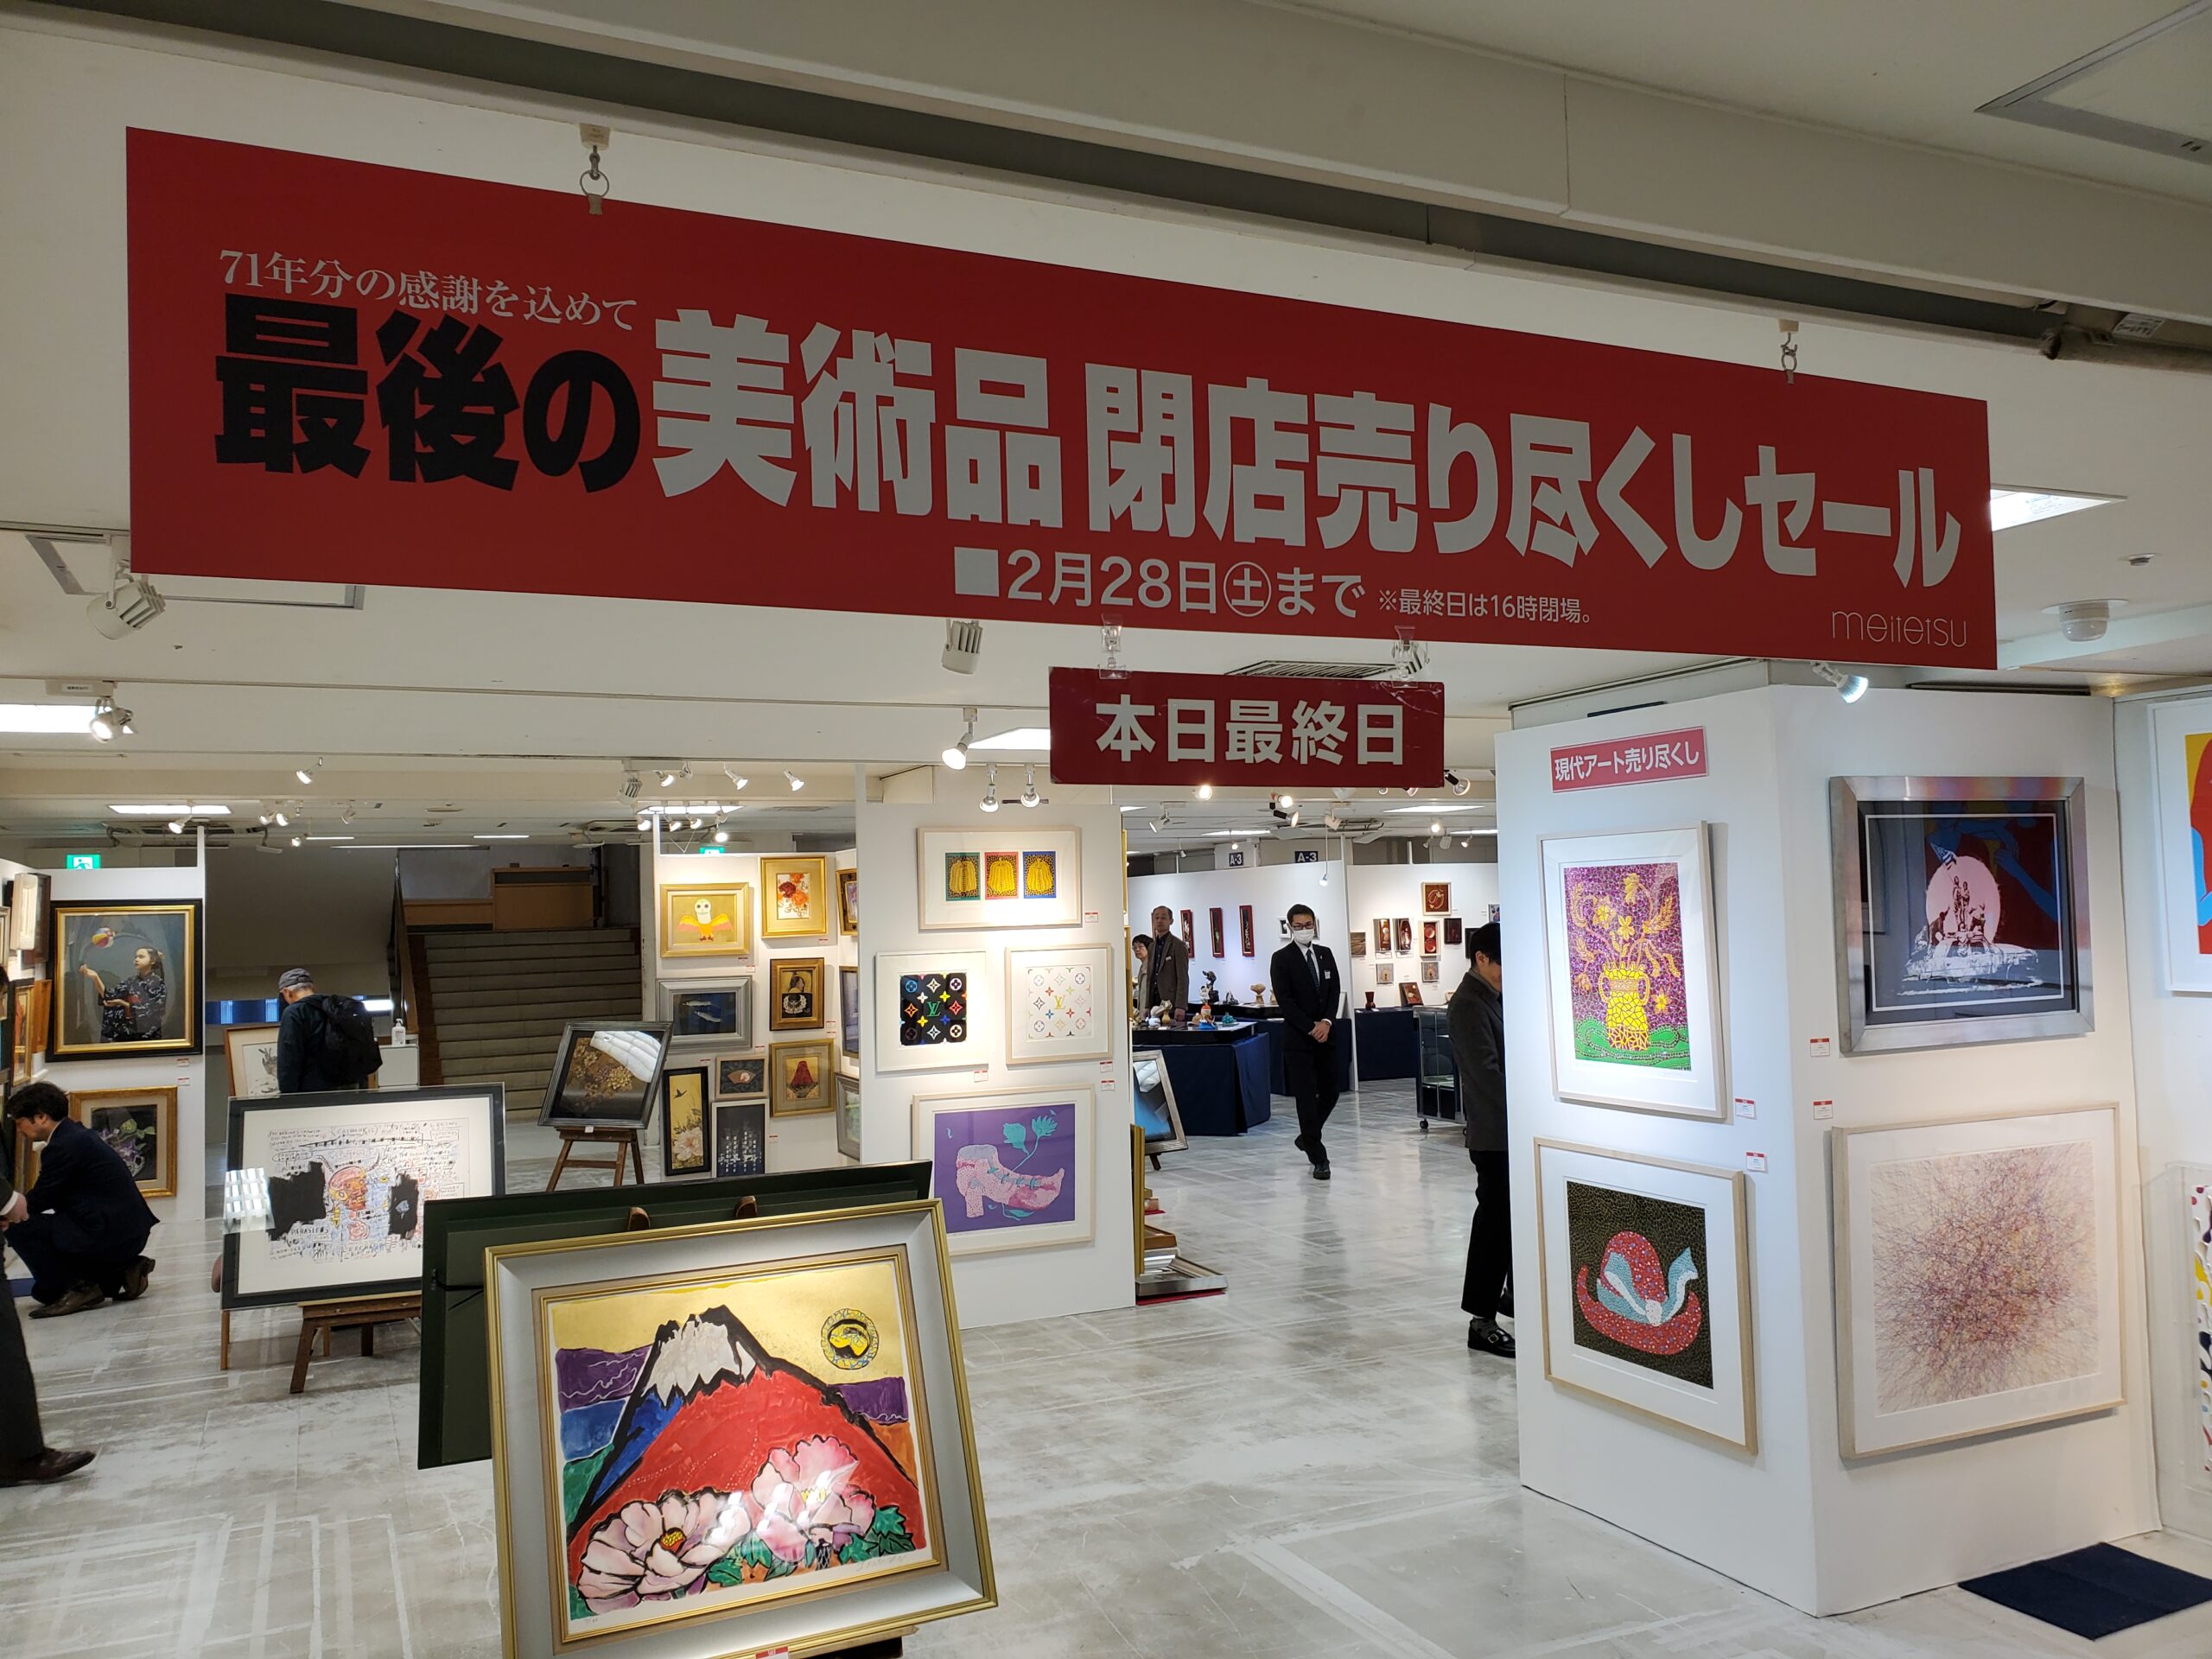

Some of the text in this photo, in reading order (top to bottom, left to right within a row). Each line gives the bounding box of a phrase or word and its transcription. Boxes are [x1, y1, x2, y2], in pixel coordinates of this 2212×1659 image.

[219, 249, 638, 331] 71年分の感謝を込めて
[1832, 610, 1967, 648] meitetsu
[1096, 693, 1405, 766] 本日最終日
[1554, 741, 1700, 782] 現代アート売り尽くし
[1230, 854, 1243, 865] A-3
[1297, 852, 1318, 863] A-3
